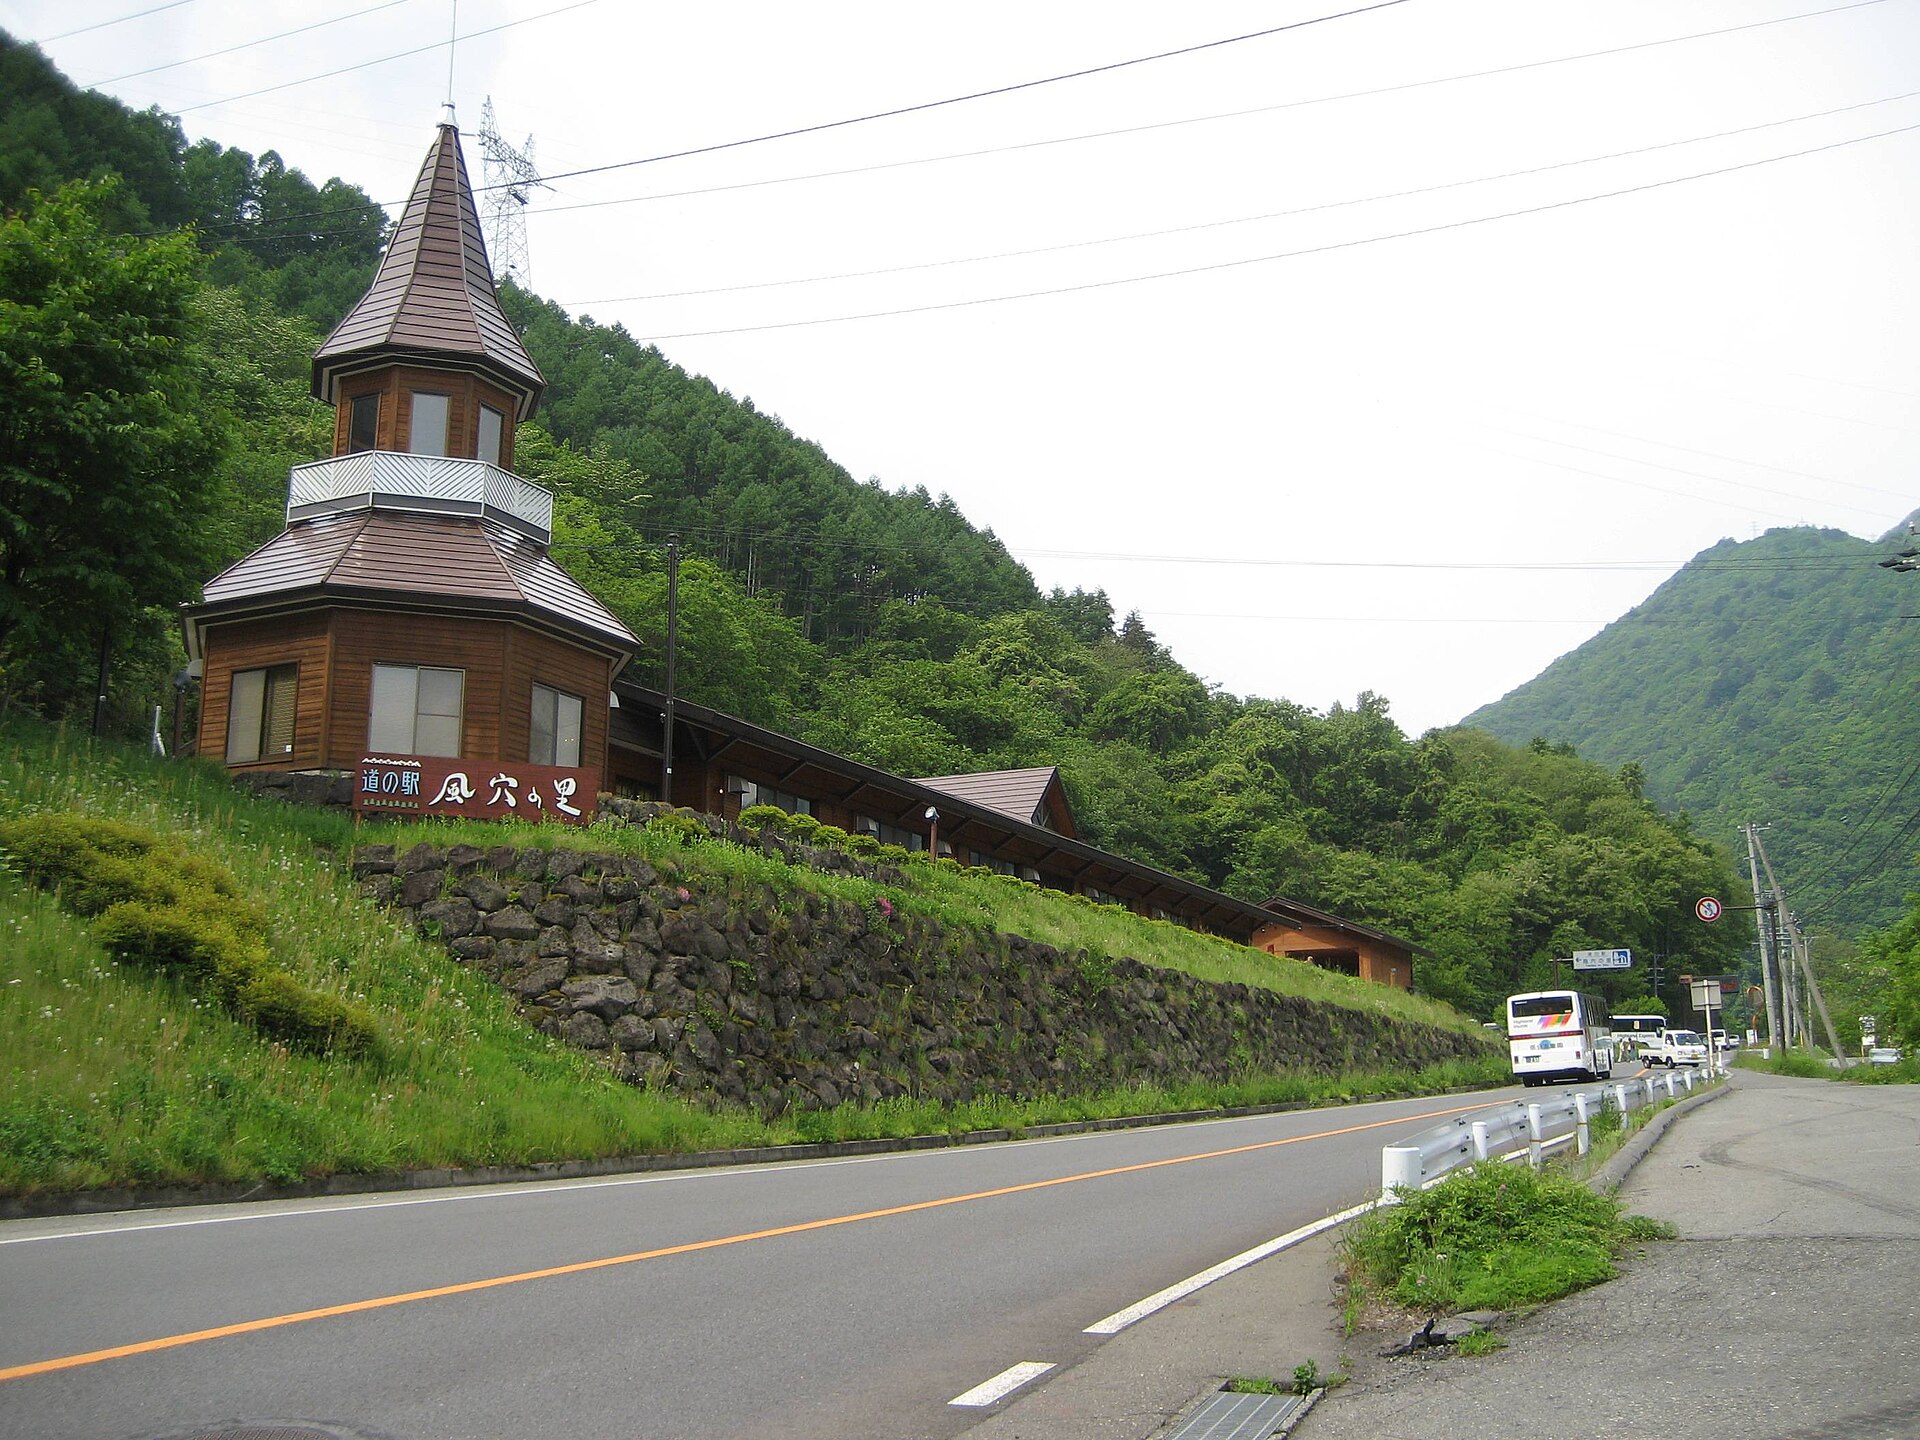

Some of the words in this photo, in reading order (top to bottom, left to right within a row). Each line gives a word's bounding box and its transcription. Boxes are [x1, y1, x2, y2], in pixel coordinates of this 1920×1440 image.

[362, 769, 420, 795] 道の駅
[428, 772, 582, 817] 風穴の里
